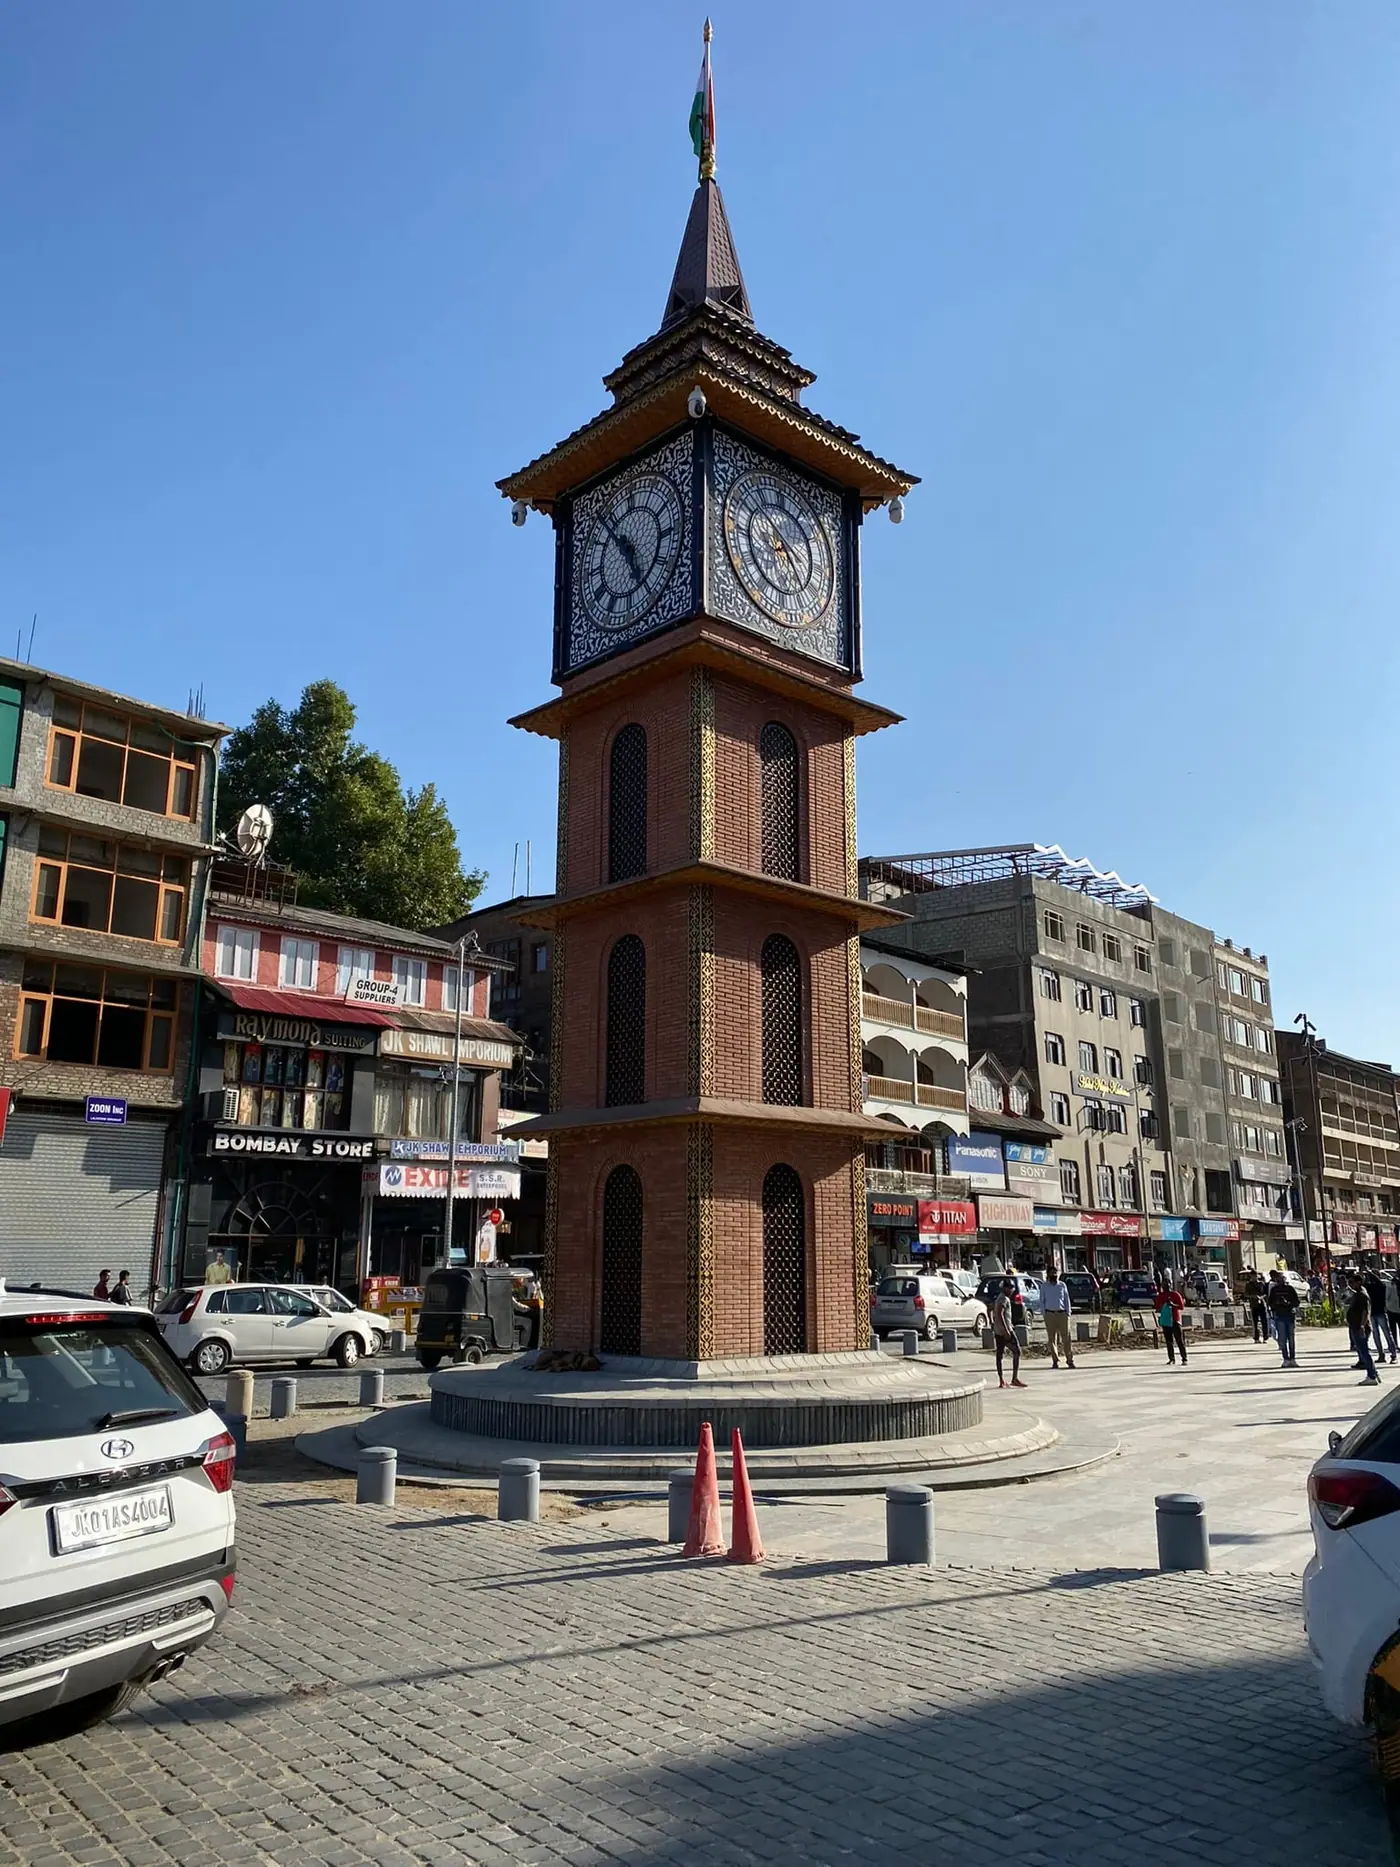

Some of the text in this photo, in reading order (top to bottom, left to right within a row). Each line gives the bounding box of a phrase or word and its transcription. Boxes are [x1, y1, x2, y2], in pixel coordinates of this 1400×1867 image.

[356, 979, 398, 996] GROUP-4
[354, 991, 396, 1005] SUPPLIERS
[324, 1033, 366, 1048] SUITING
[383, 1030, 404, 1053] JK
[408, 1034, 449, 1055] SHAWL
[90, 1103, 111, 1114] ZOON
[215, 1133, 373, 1157] BOMBAY STORE
[407, 1142, 506, 1156] JK SHAW EMPORIUM
[955, 1142, 997, 1158] Panasonic
[1020, 1166, 1047, 1178] SONY
[873, 1203, 914, 1217] ZERO POINT
[941, 1210, 967, 1225] TITAN
[981, 1200, 1030, 1222] RIGHTWAY
